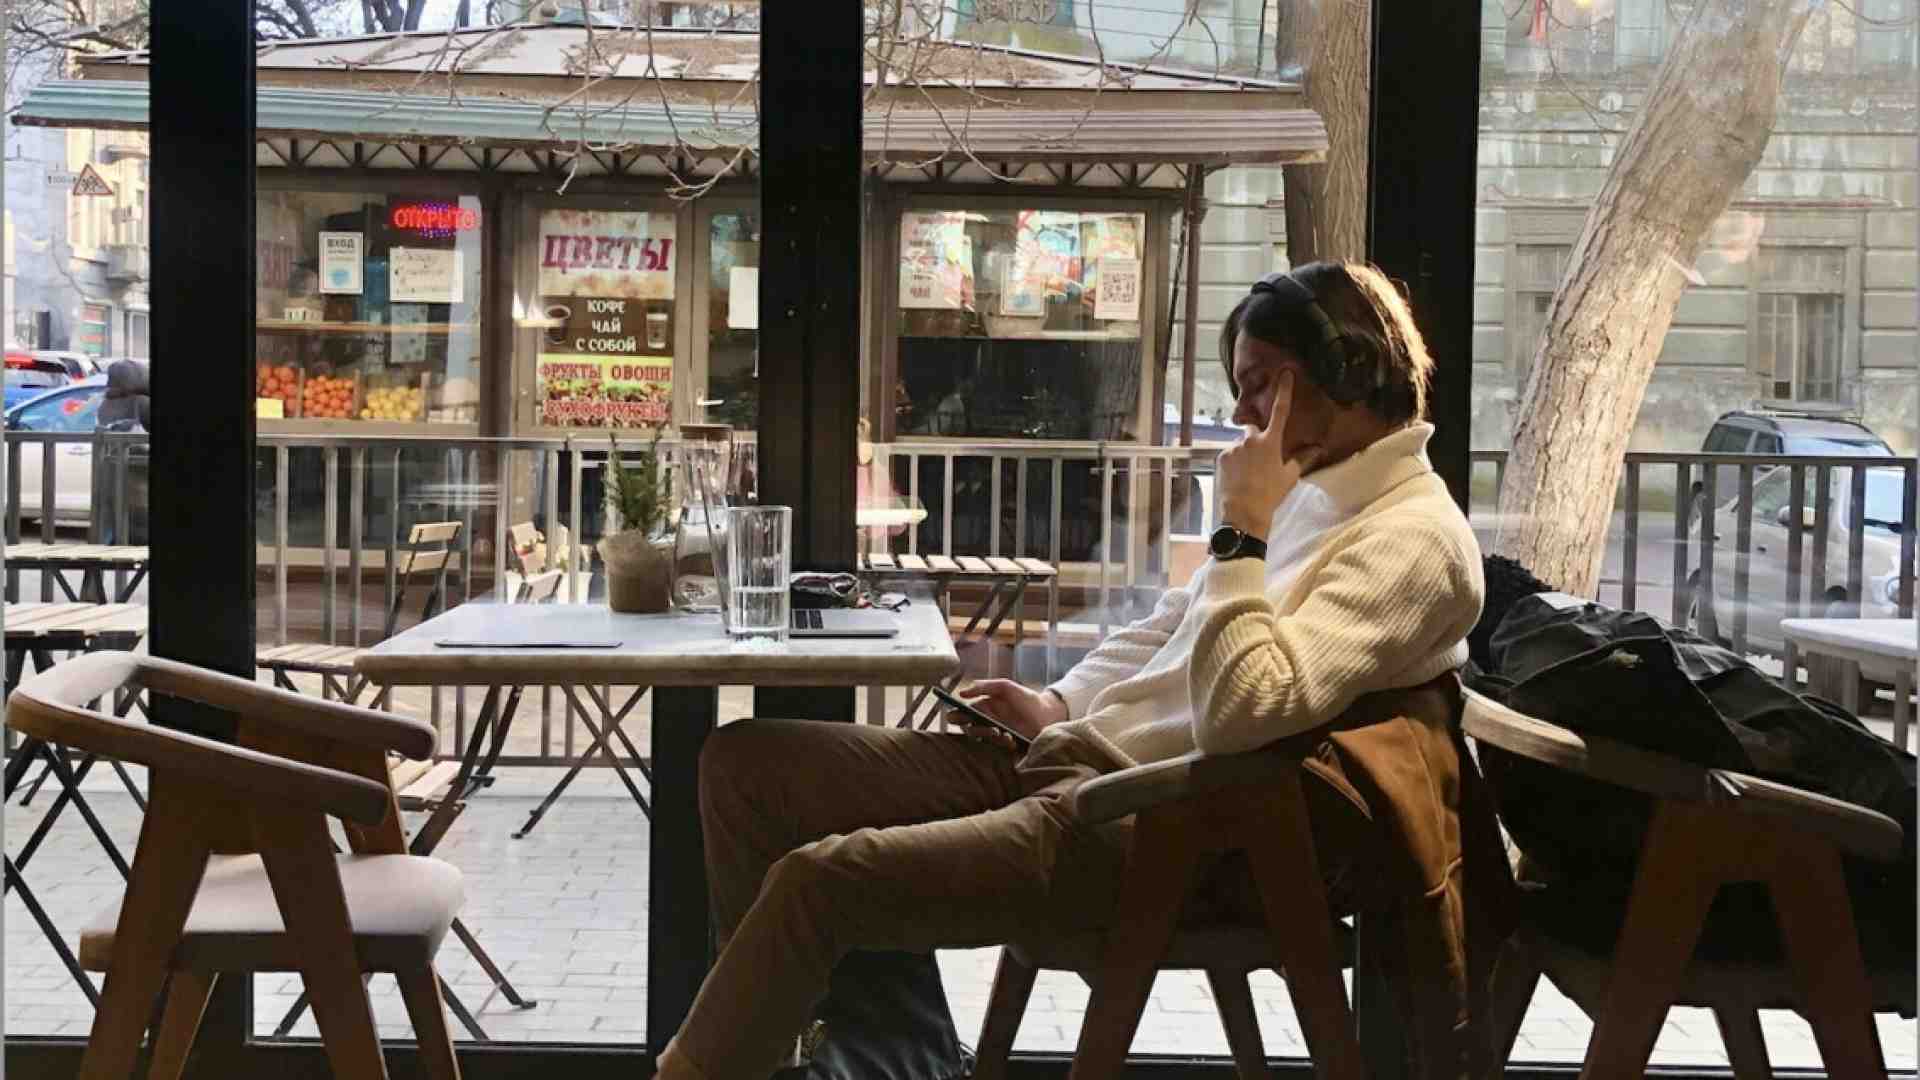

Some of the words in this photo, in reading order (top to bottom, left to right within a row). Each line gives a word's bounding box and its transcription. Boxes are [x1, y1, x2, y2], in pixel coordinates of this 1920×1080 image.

[393, 206, 477, 231] ОТКРЫТО
[542, 235, 673, 274] ЦВЕТЫ
[587, 299, 626, 313] КОФЕ
[591, 317, 621, 333] ЧАЙ
[576, 338, 585, 350] С
[589, 336, 637, 352] СОБОЙ
[540, 363, 601, 380] ФРУКТЫ
